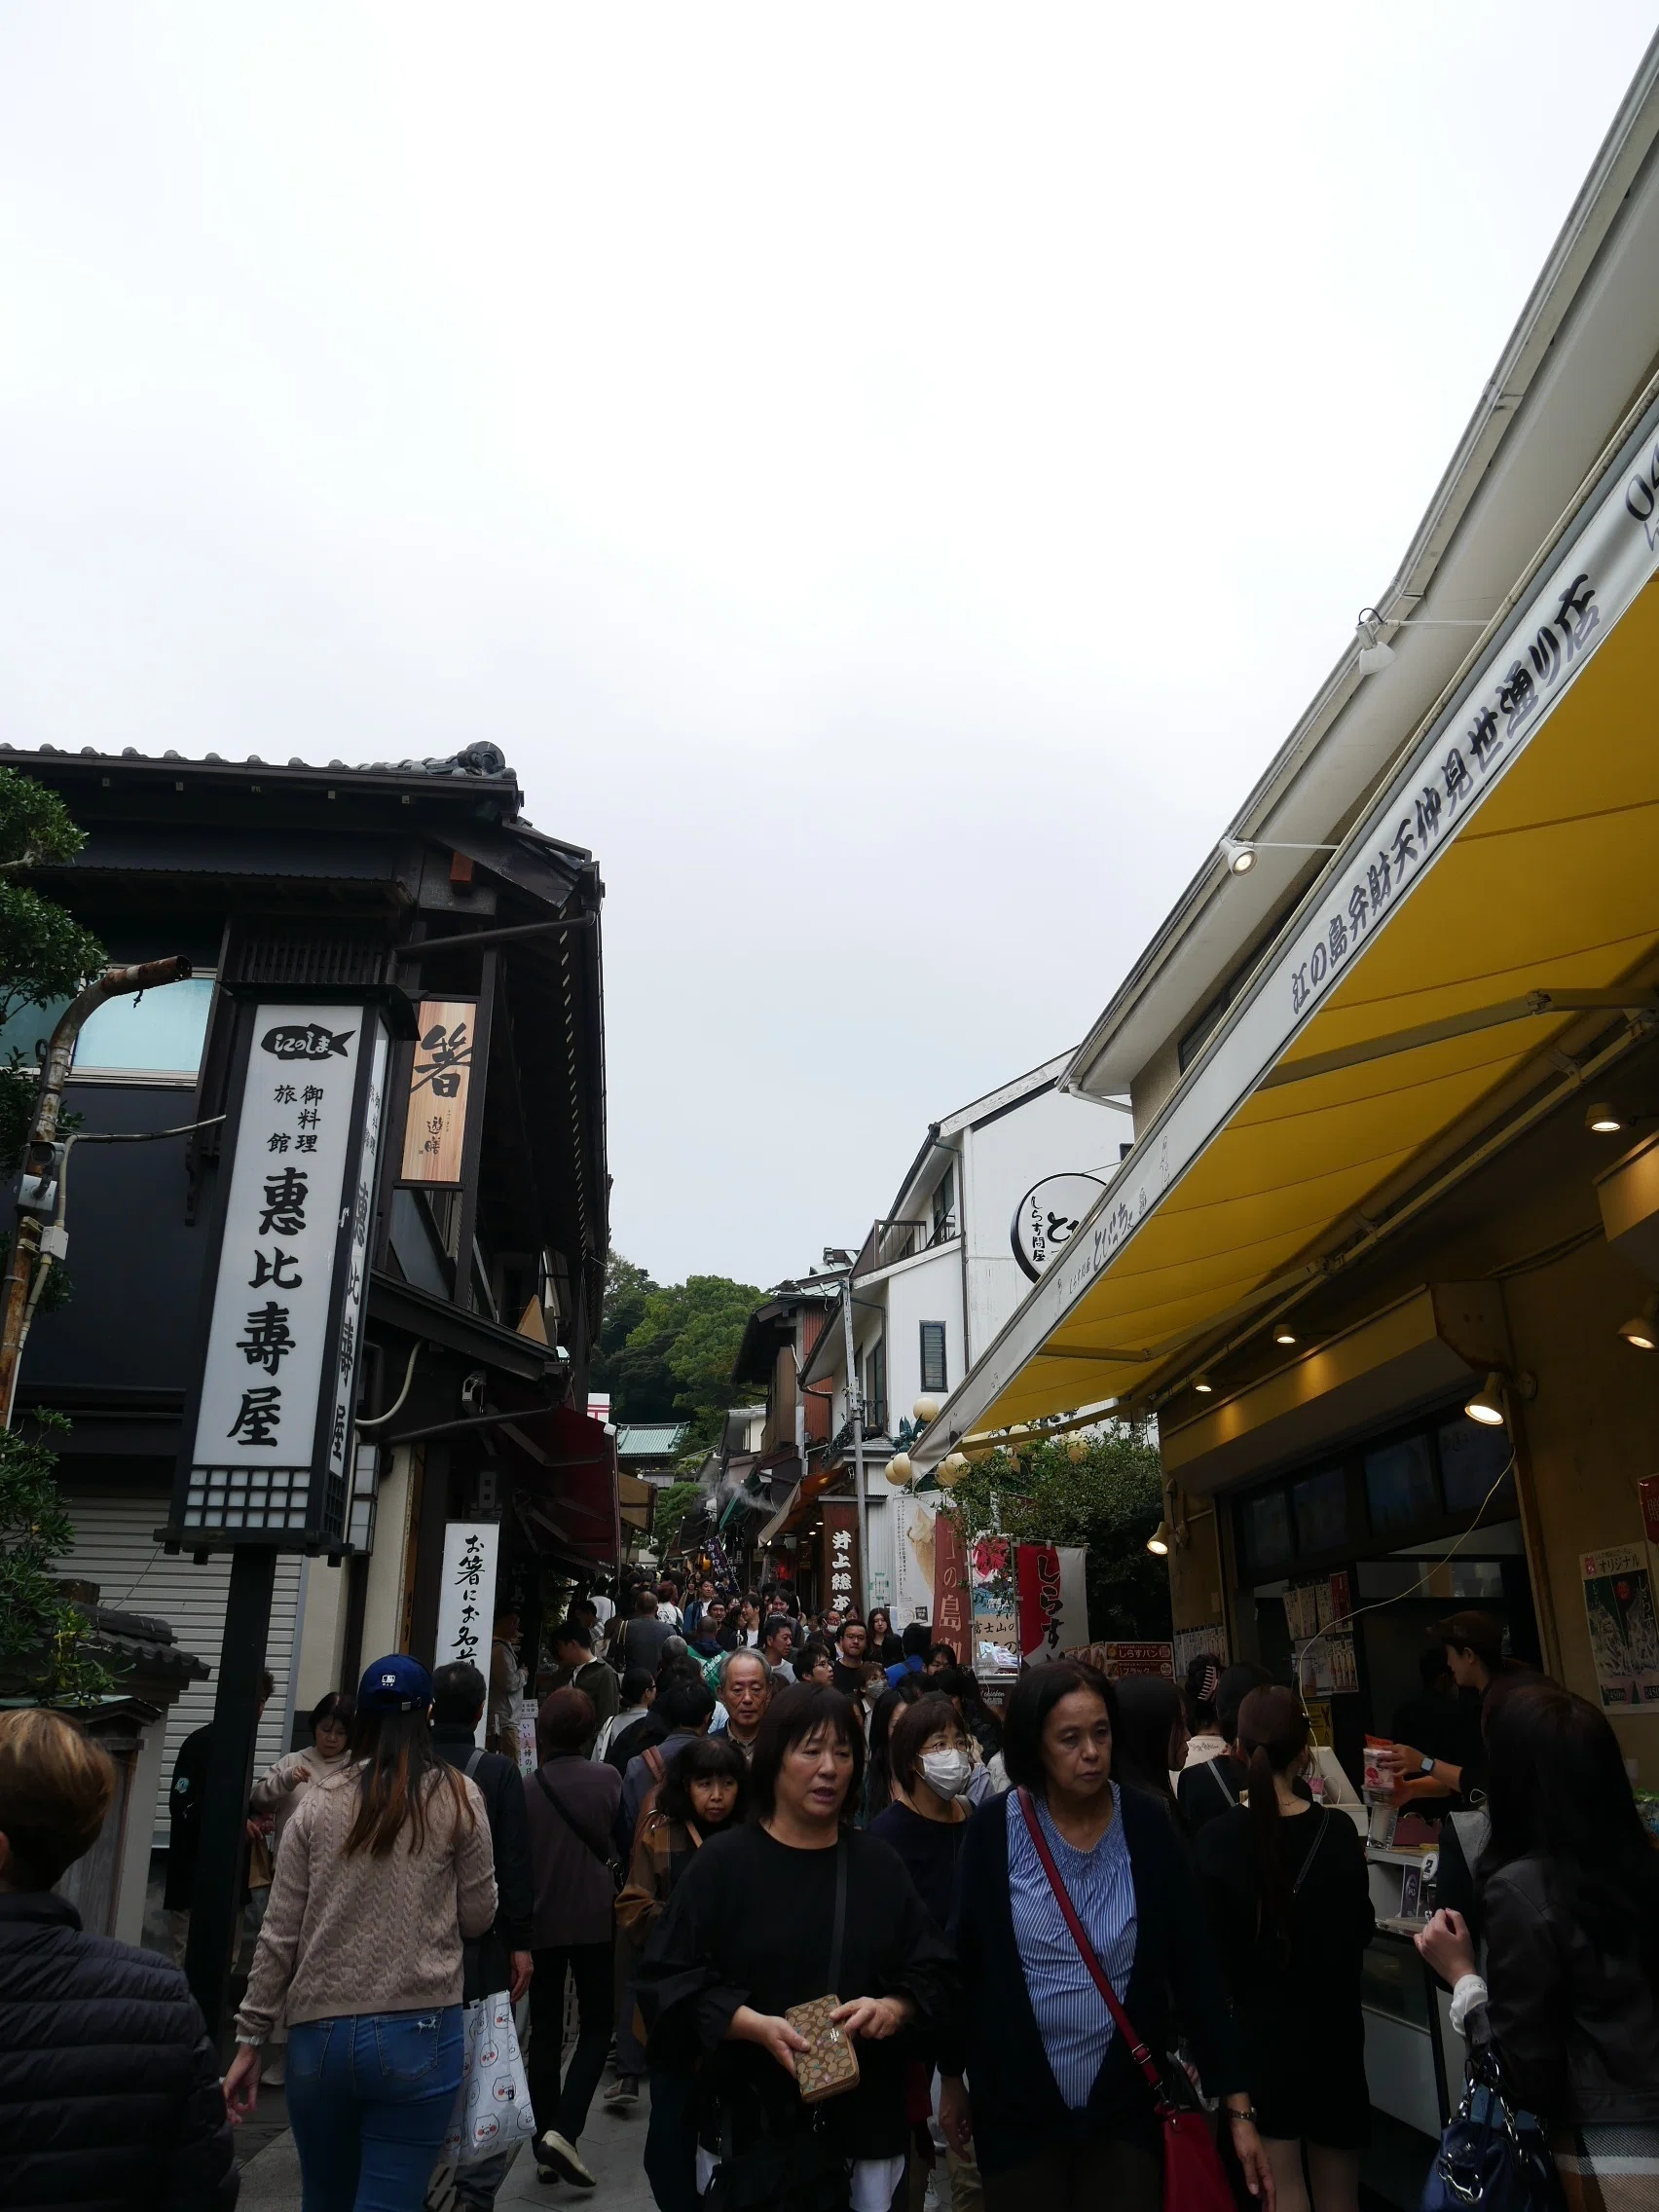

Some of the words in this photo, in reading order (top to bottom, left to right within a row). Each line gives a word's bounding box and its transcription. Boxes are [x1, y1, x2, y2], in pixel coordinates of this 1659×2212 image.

[1291, 572, 1600, 1014] 江の島弁財天仲見世通り店
[410, 1023, 472, 1097] 箸
[268, 1085, 297, 1153] 旅館
[295, 1085, 323, 1154] 御料理
[1030, 1196, 1046, 1263] しらす問屋
[831, 1530, 852, 1621] 井上総本
[1599, 1554, 1640, 1573] オリジナル
[1037, 1555, 1064, 1658] しらす
[702, 1653, 723, 1677] orldwide
[1119, 1649, 1159, 1658] しらすパン
[522, 1722, 533, 1776] いい夫婦の日
